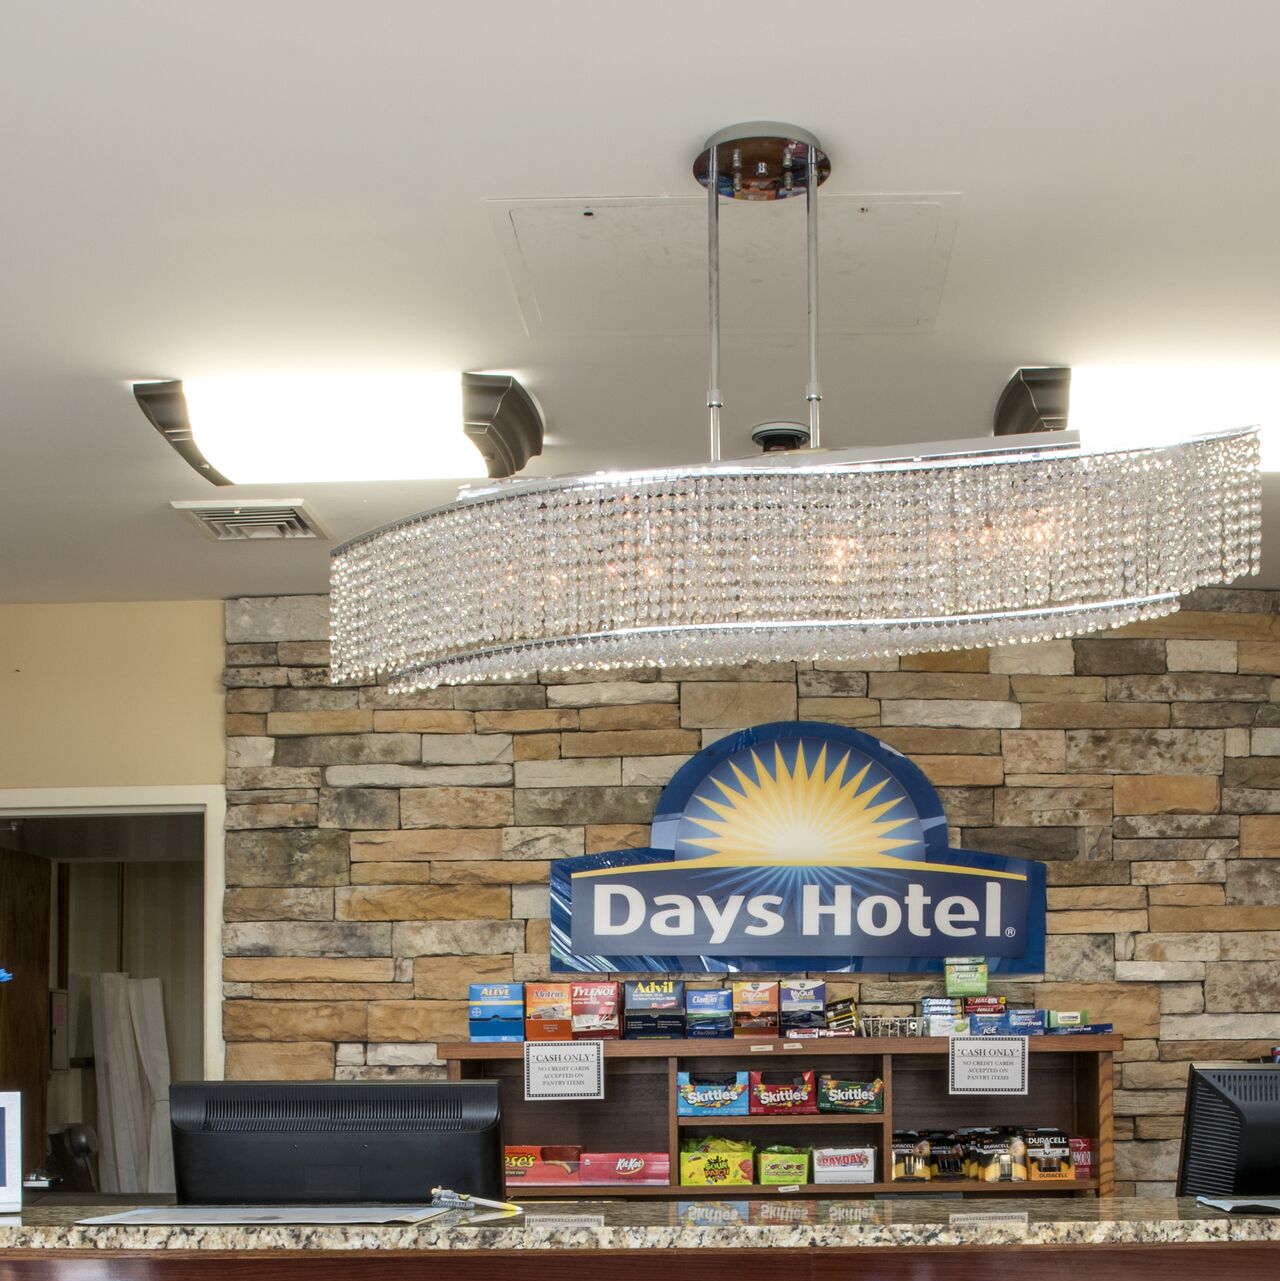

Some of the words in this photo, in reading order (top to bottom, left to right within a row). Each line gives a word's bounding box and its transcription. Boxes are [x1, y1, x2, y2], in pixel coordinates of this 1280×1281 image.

[593, 884, 785, 944] Days
[802, 881, 1001, 936] Hotel
[480, 987, 511, 996] ALEVE
[572, 986, 615, 998] TYLENOL
[633, 981, 673, 993] Advil
[687, 1089, 738, 1104] Skittles
[760, 1089, 808, 1104] Skittles
[828, 1088, 875, 1101] Skittles
[821, 1153, 864, 1167] PAYDAY
[705, 1169, 730, 1177] PATCH
